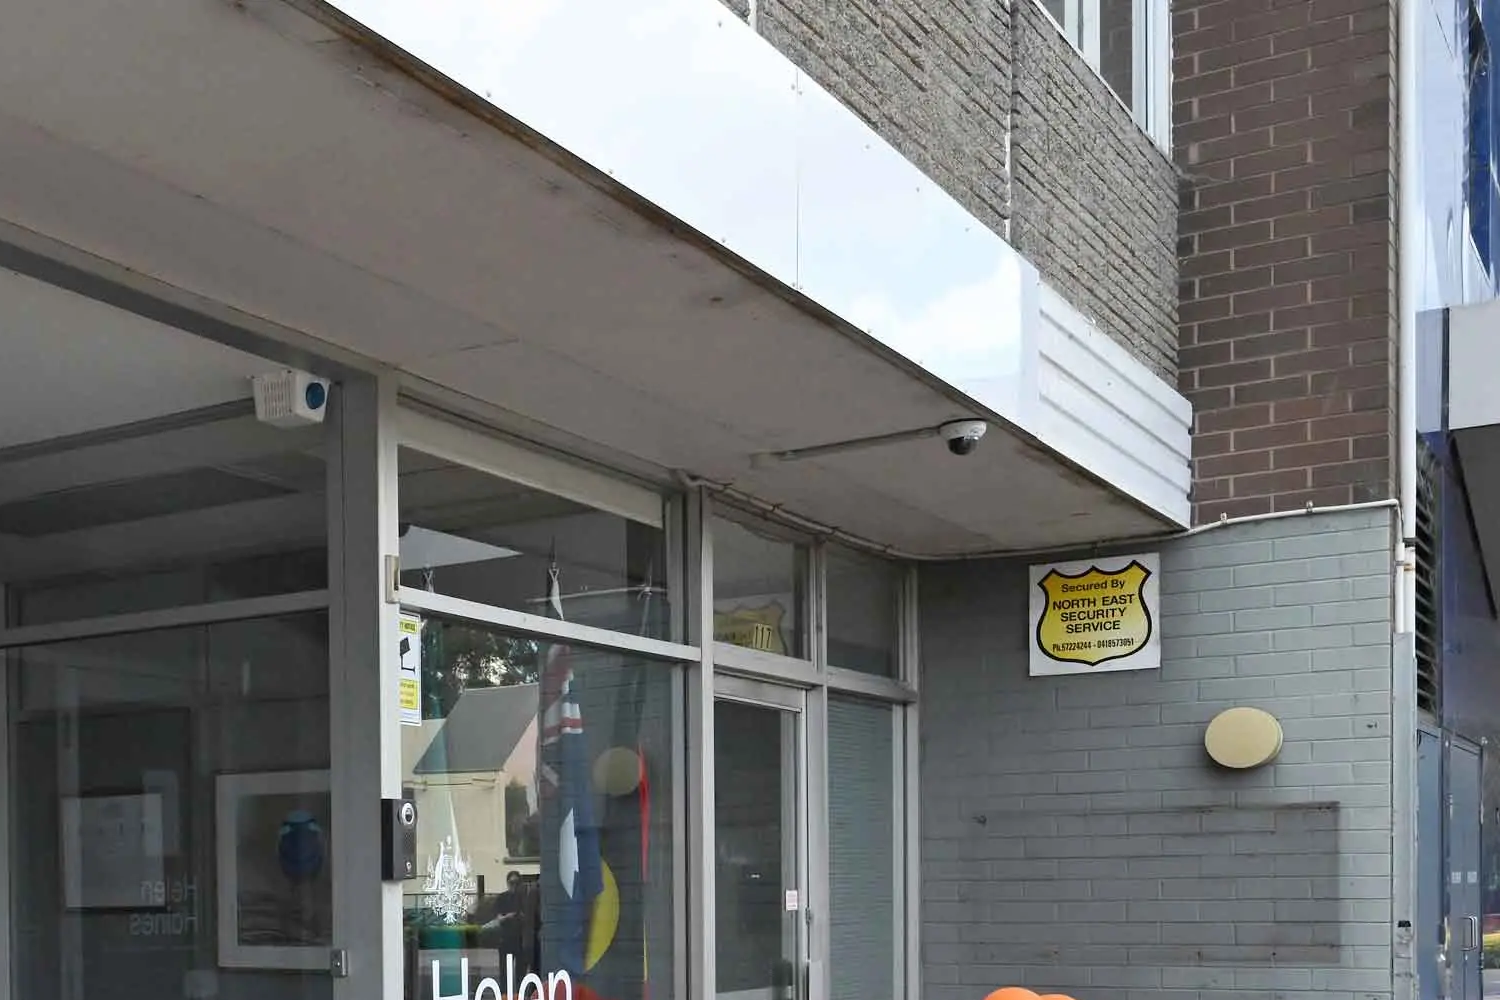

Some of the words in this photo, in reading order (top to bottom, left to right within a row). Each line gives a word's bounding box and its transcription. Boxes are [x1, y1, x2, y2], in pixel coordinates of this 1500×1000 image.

[1061, 580, 1108, 593] Secured
[1111, 579, 1125, 590] By
[1053, 597, 1097, 611] NORTH
[1102, 593, 1135, 607] EAST
[1060, 607, 1127, 622] SECURITY
[1066, 620, 1121, 634] SERVICE
[755, 625, 772, 649] 117
